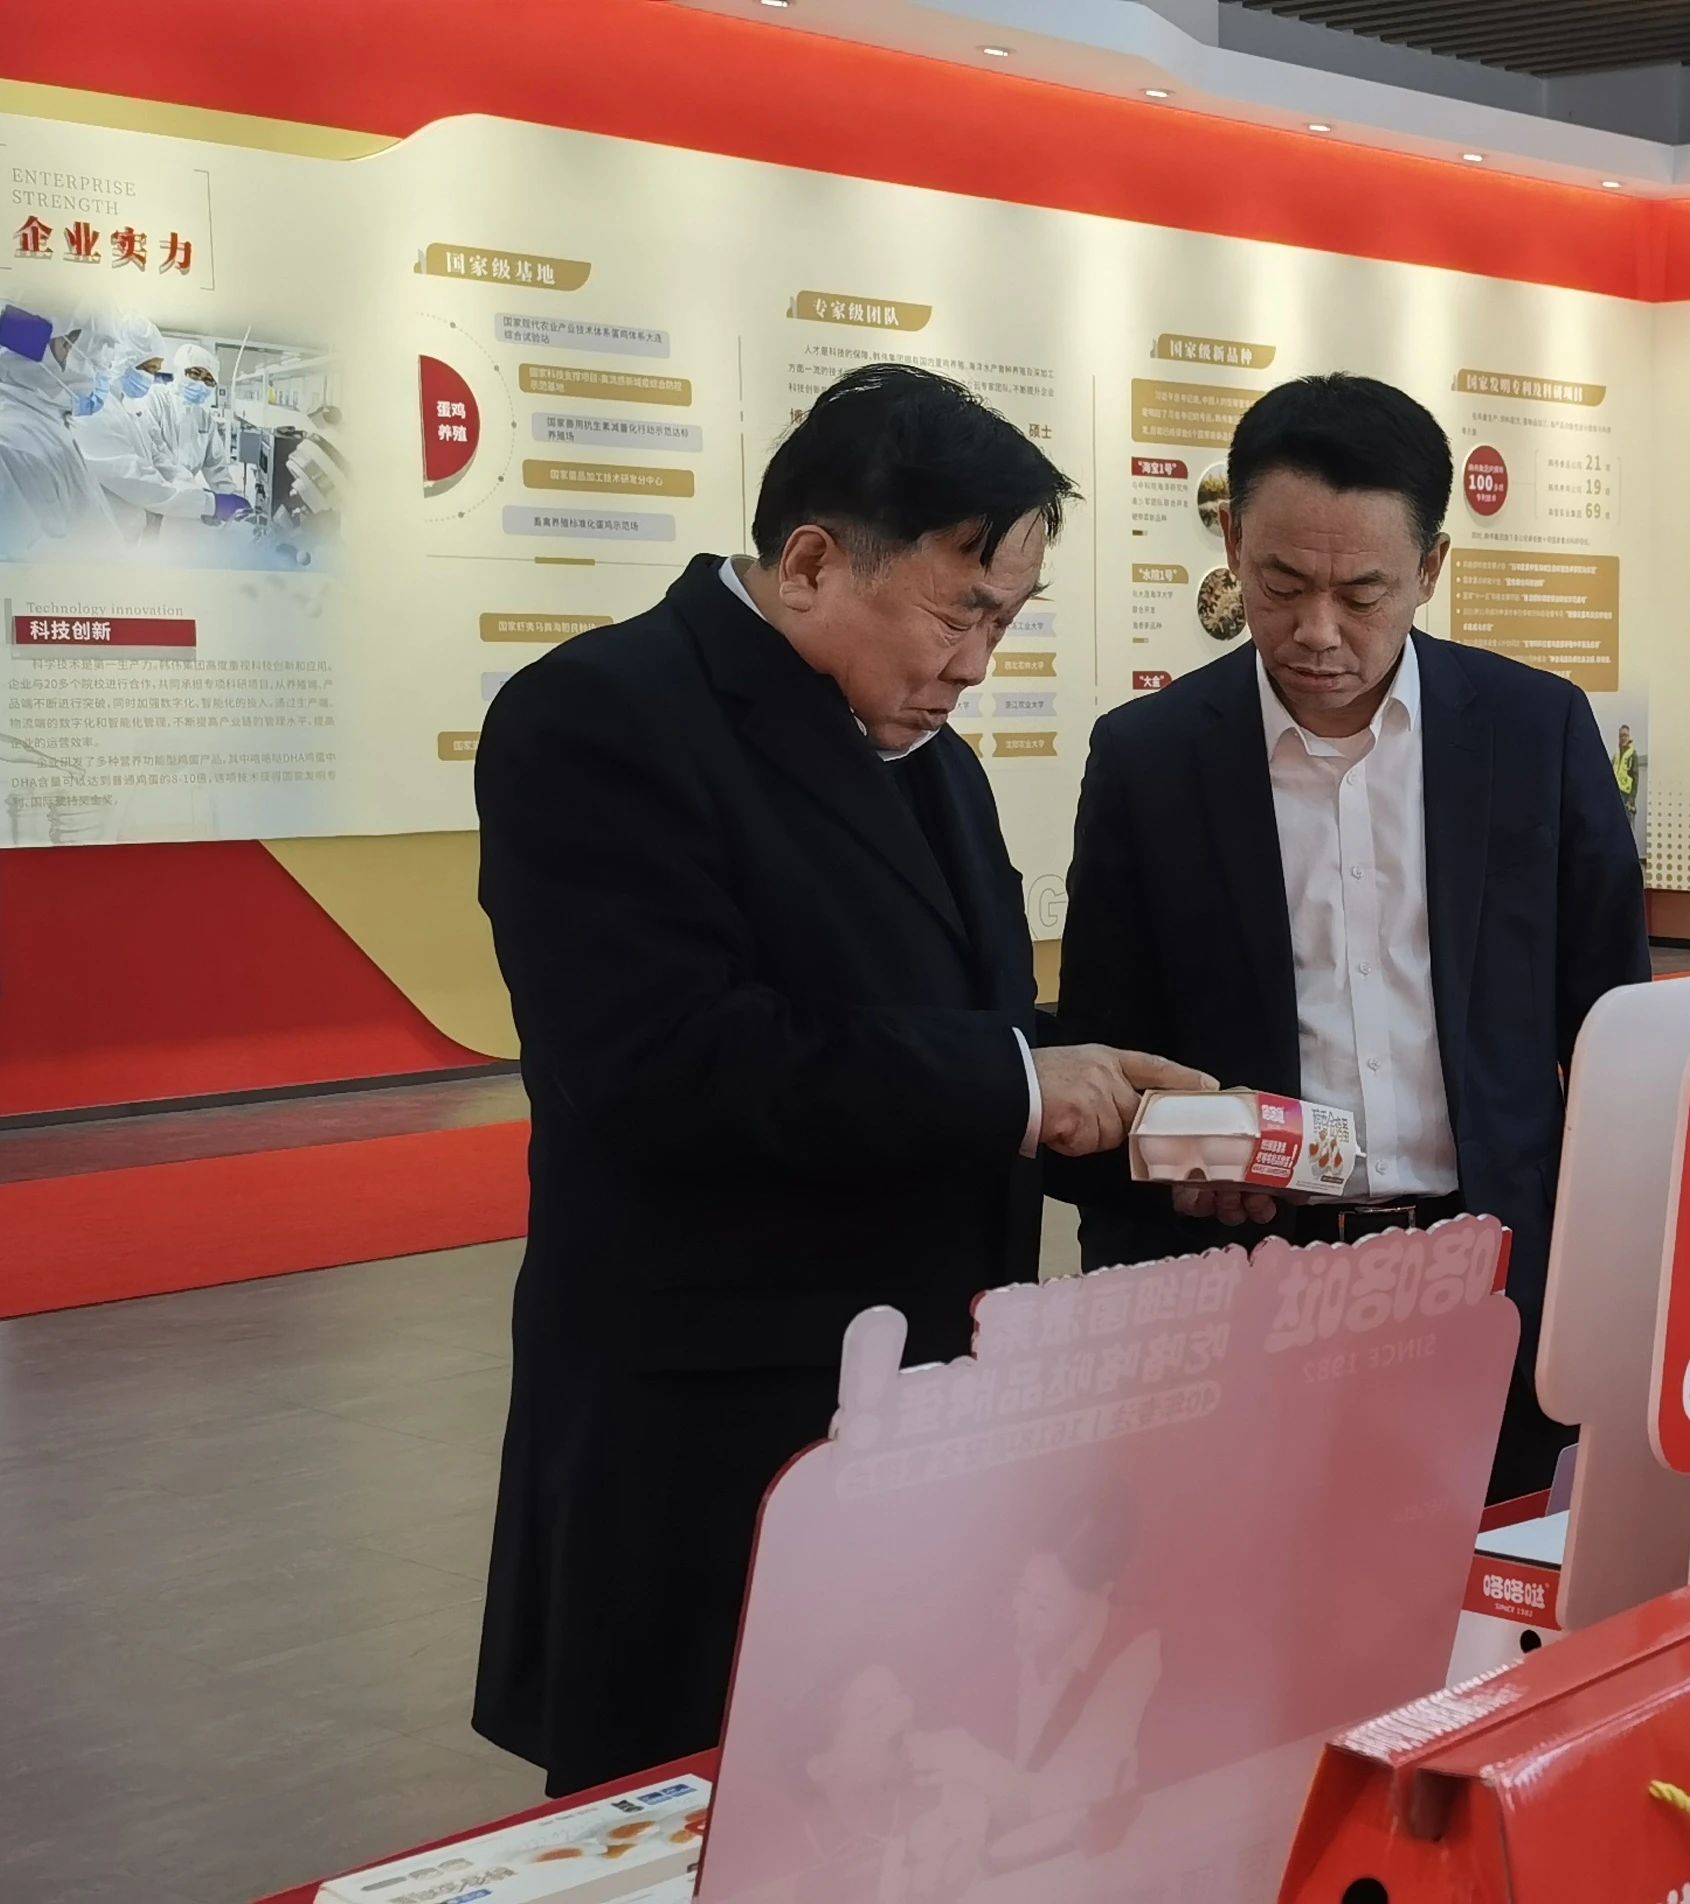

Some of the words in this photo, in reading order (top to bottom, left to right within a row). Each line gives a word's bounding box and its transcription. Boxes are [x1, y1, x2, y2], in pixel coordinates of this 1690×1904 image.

[12, 168, 136, 197] ENTERPRISE
[12, 190, 119, 216] STRENGTH
[13, 215, 193, 275] 企业实力
[446, 251, 556, 285] 国家级基地
[813, 298, 900, 326] 专家级团队
[1170, 339, 1253, 365] 国家级新品种
[436, 401, 466, 419] 蛋鸡
[437, 425, 468, 442] 养殖
[1029, 424, 1052, 439] 硕士
[1585, 455, 1602, 471] 21
[1469, 474, 1493, 491] 100
[1585, 478, 1602, 495] 19
[1585, 502, 1602, 518] 69
[26, 602, 106, 616] Technology
[111, 603, 184, 617] innovation
[30, 620, 112, 642] 科技创新
[1483, 1574, 1546, 1609] 咯咯哒
